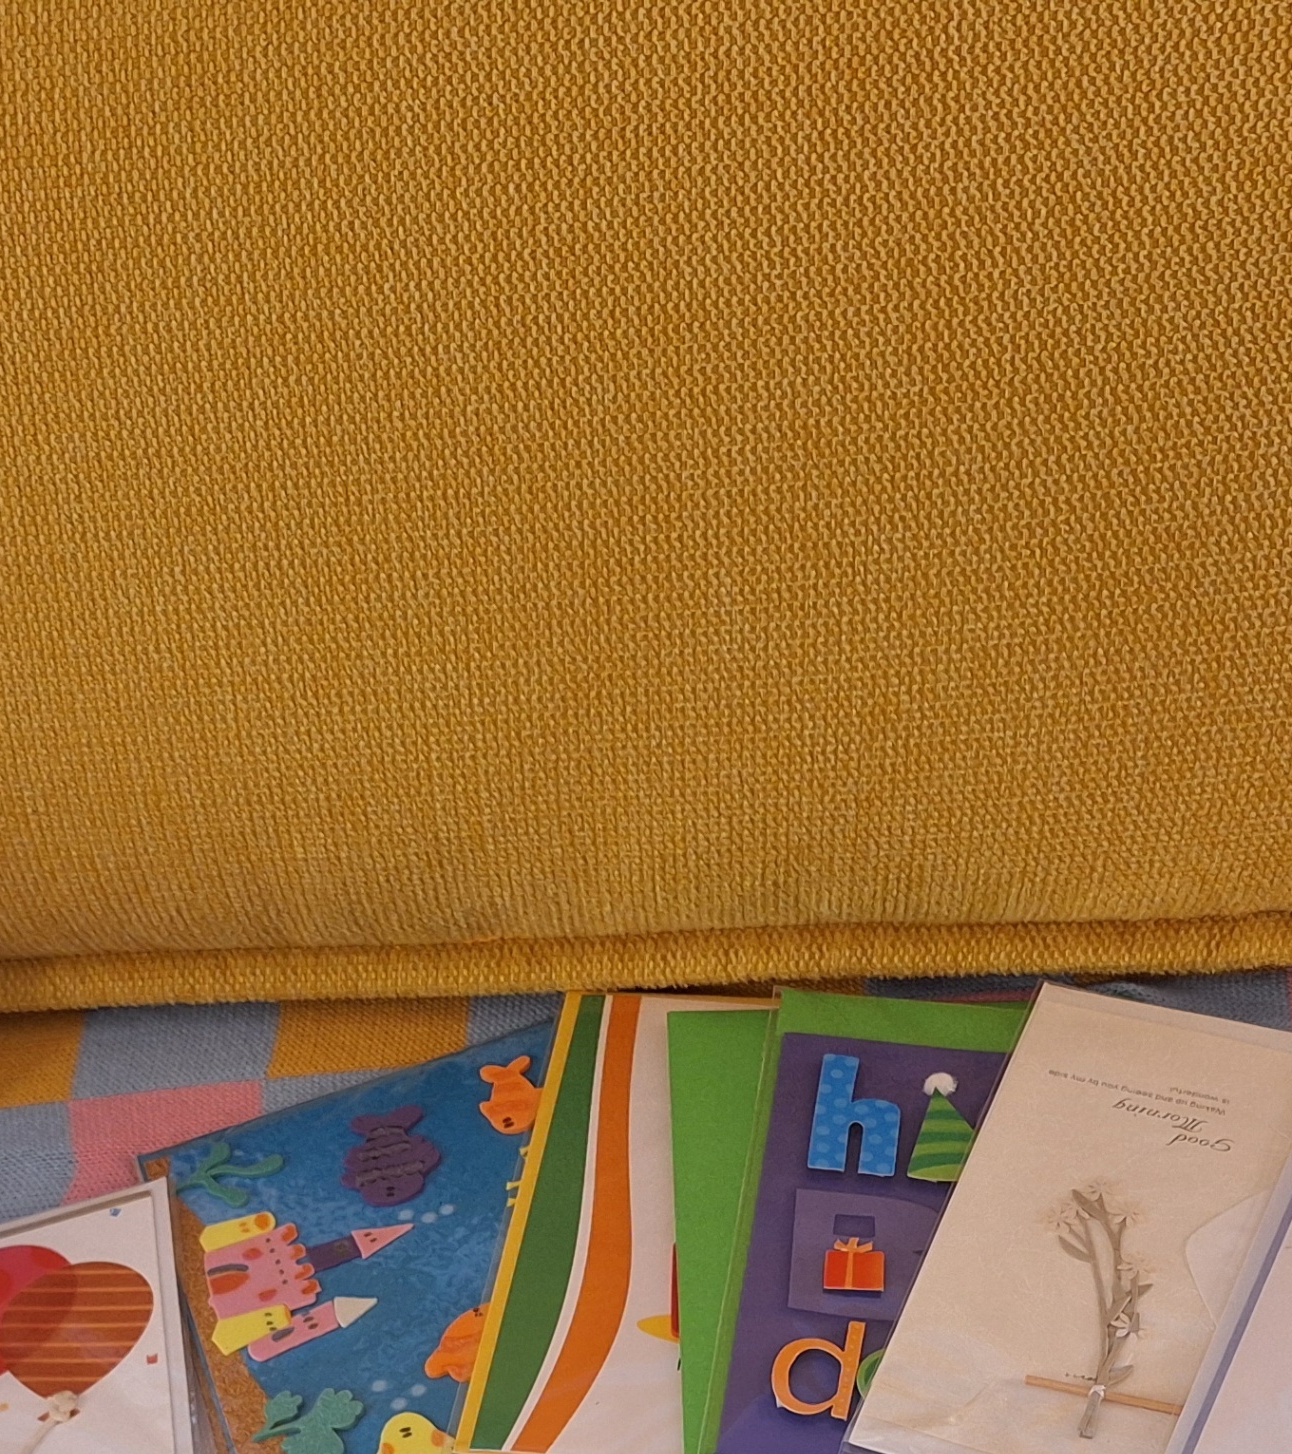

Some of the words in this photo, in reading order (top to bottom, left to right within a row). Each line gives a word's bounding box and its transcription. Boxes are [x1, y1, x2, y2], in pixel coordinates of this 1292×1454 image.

[1048, 1068, 1069, 1079] side
[1071, 1073, 1086, 1083] my
[1088, 1077, 1099, 1086] by
[1101, 1081, 1119, 1092] you
[1121, 1085, 1154, 1100] seeing
[1170, 1086, 1219, 1103] wonderful
[1155, 1093, 1174, 1104] and
[1175, 1098, 1188, 1108] up
[1189, 1100, 1226, 1116] Waking
[1111, 1098, 1209, 1133] Morning
[1165, 1131, 1236, 1153] Good
